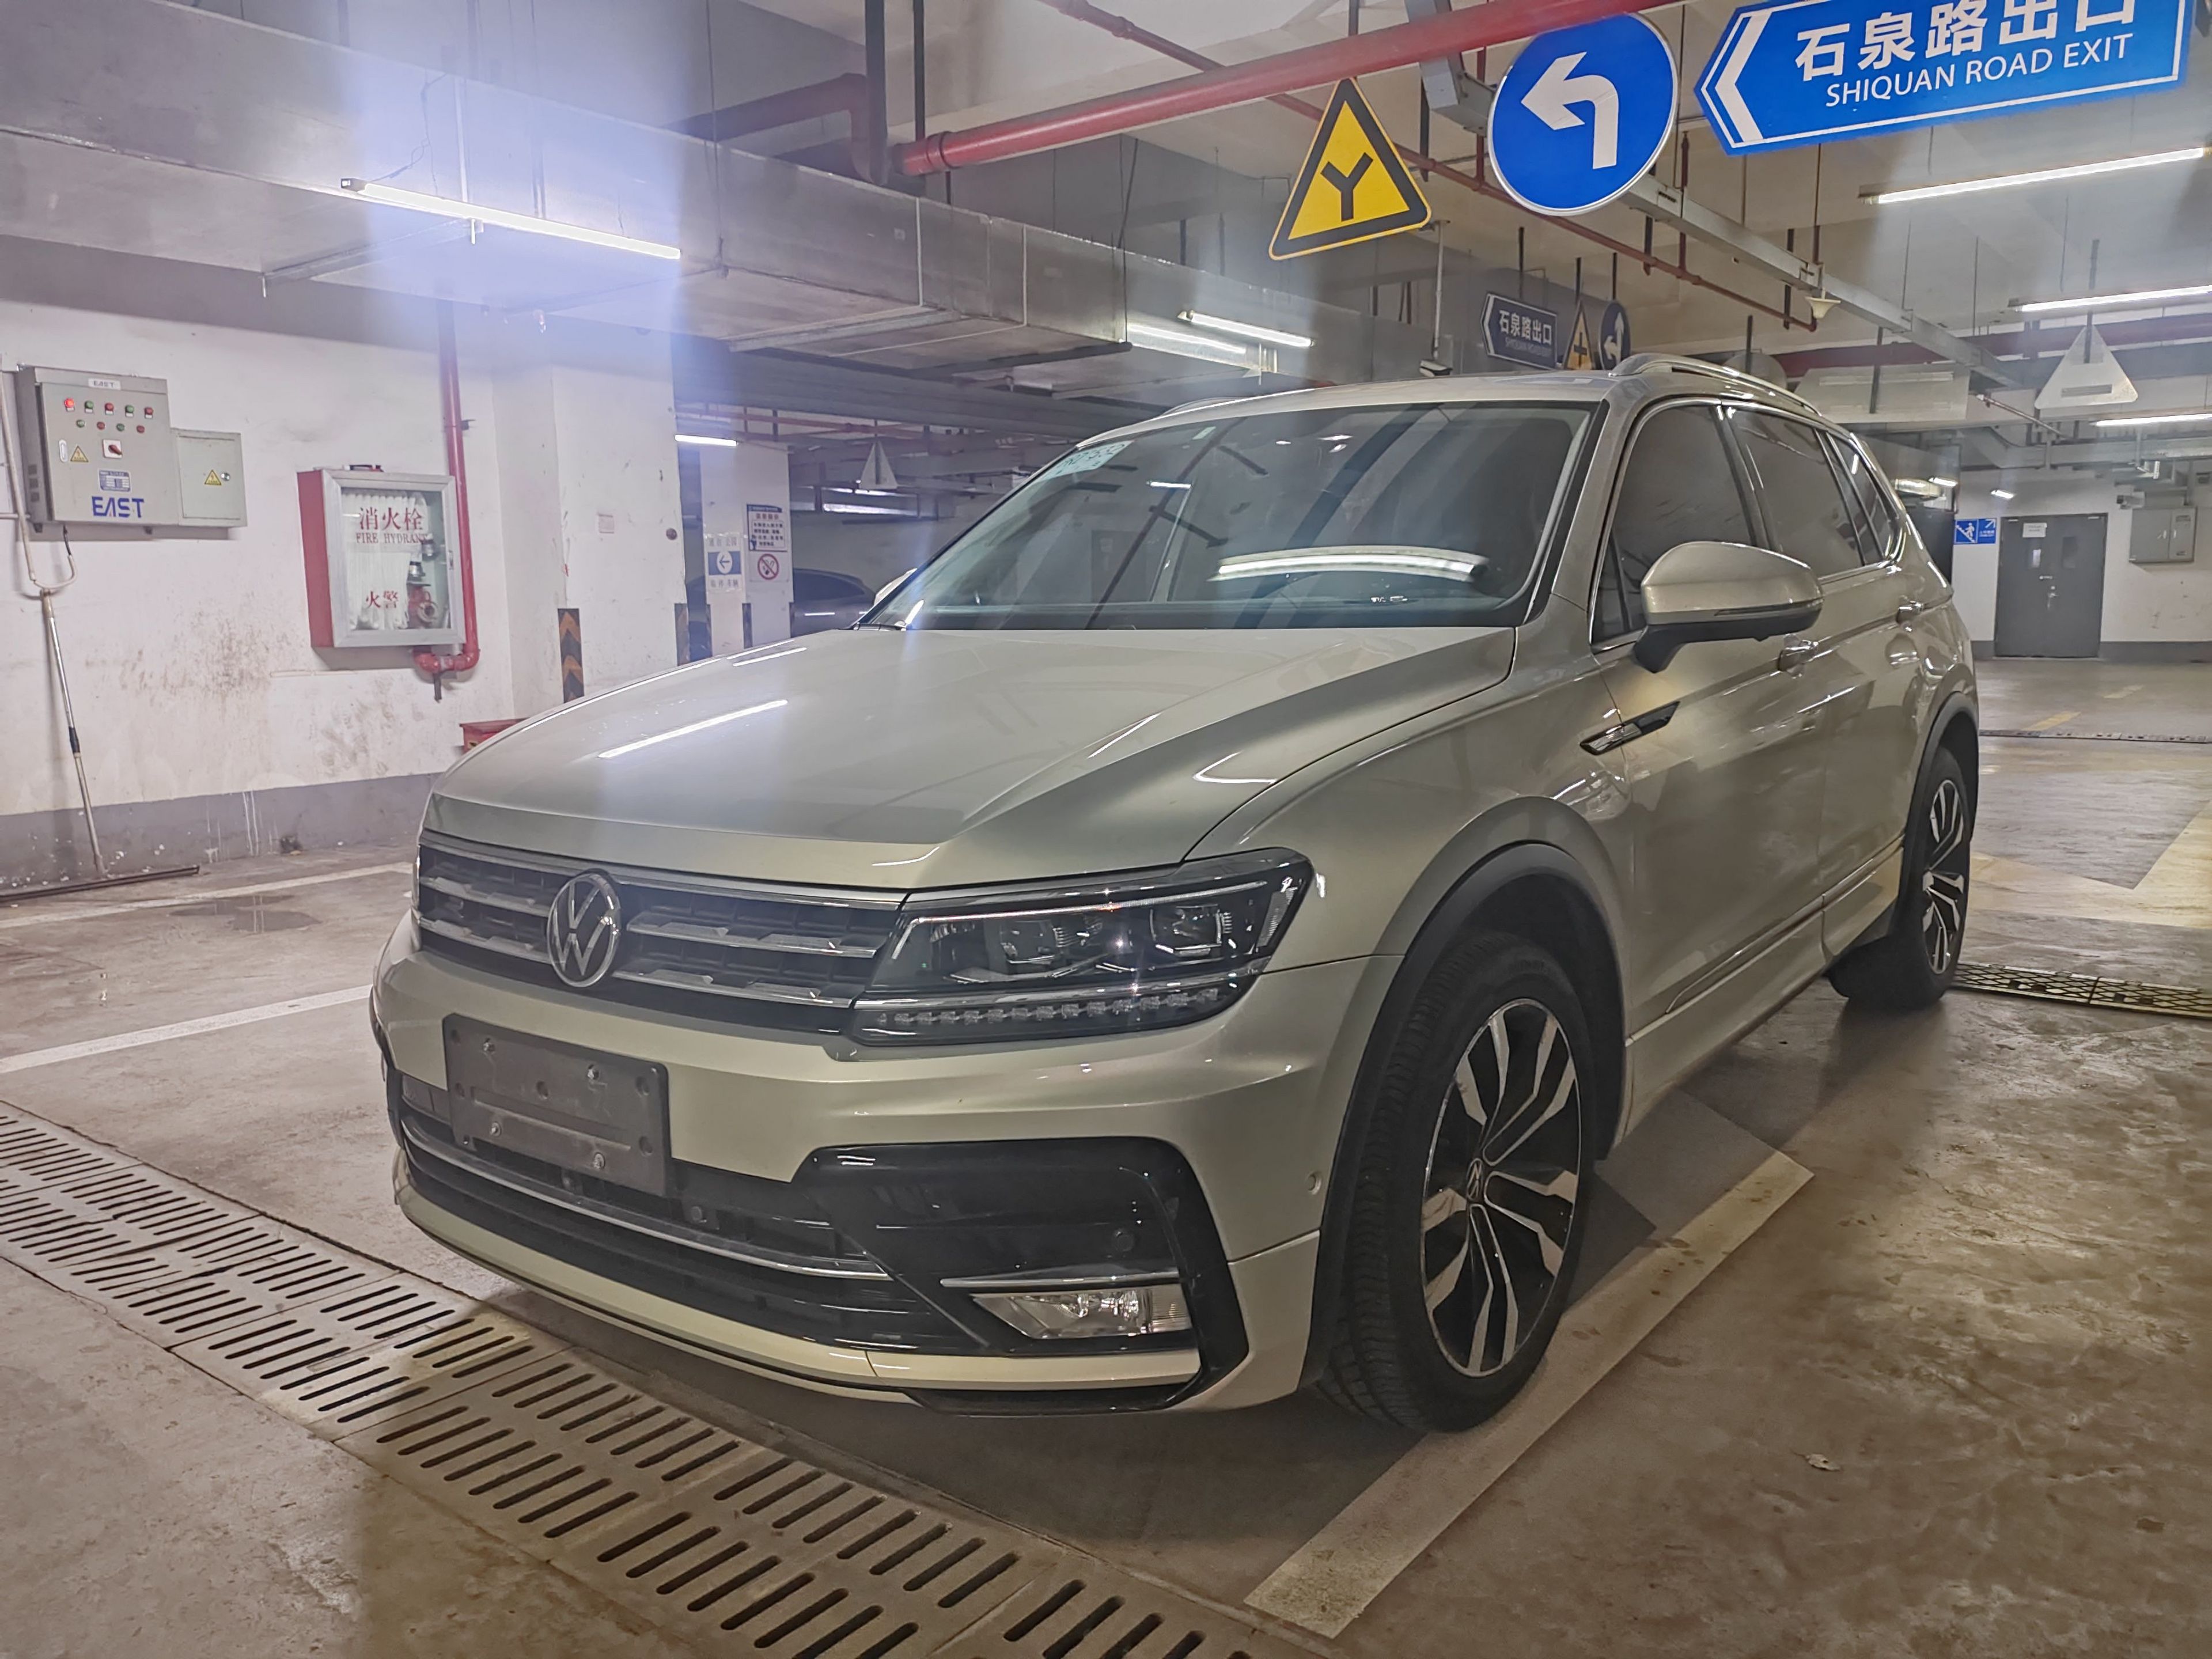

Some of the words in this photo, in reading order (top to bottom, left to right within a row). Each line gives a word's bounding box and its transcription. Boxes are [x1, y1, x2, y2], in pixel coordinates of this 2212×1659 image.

[1795, 0, 2135, 81] 石泉路出口
[1825, 64, 1955, 107] SHIQUAN
[1965, 48, 2052, 84] ROAD
[2063, 33, 2134, 69] EXIT
[1499, 310, 1552, 345] 石泉路出口
[92, 496, 145, 518] EAST
[359, 506, 423, 531] 消火栓
[357, 533, 378, 544] FIRE
[384, 533, 428, 544] HYDRANT
[366, 590, 399, 609] 火警
